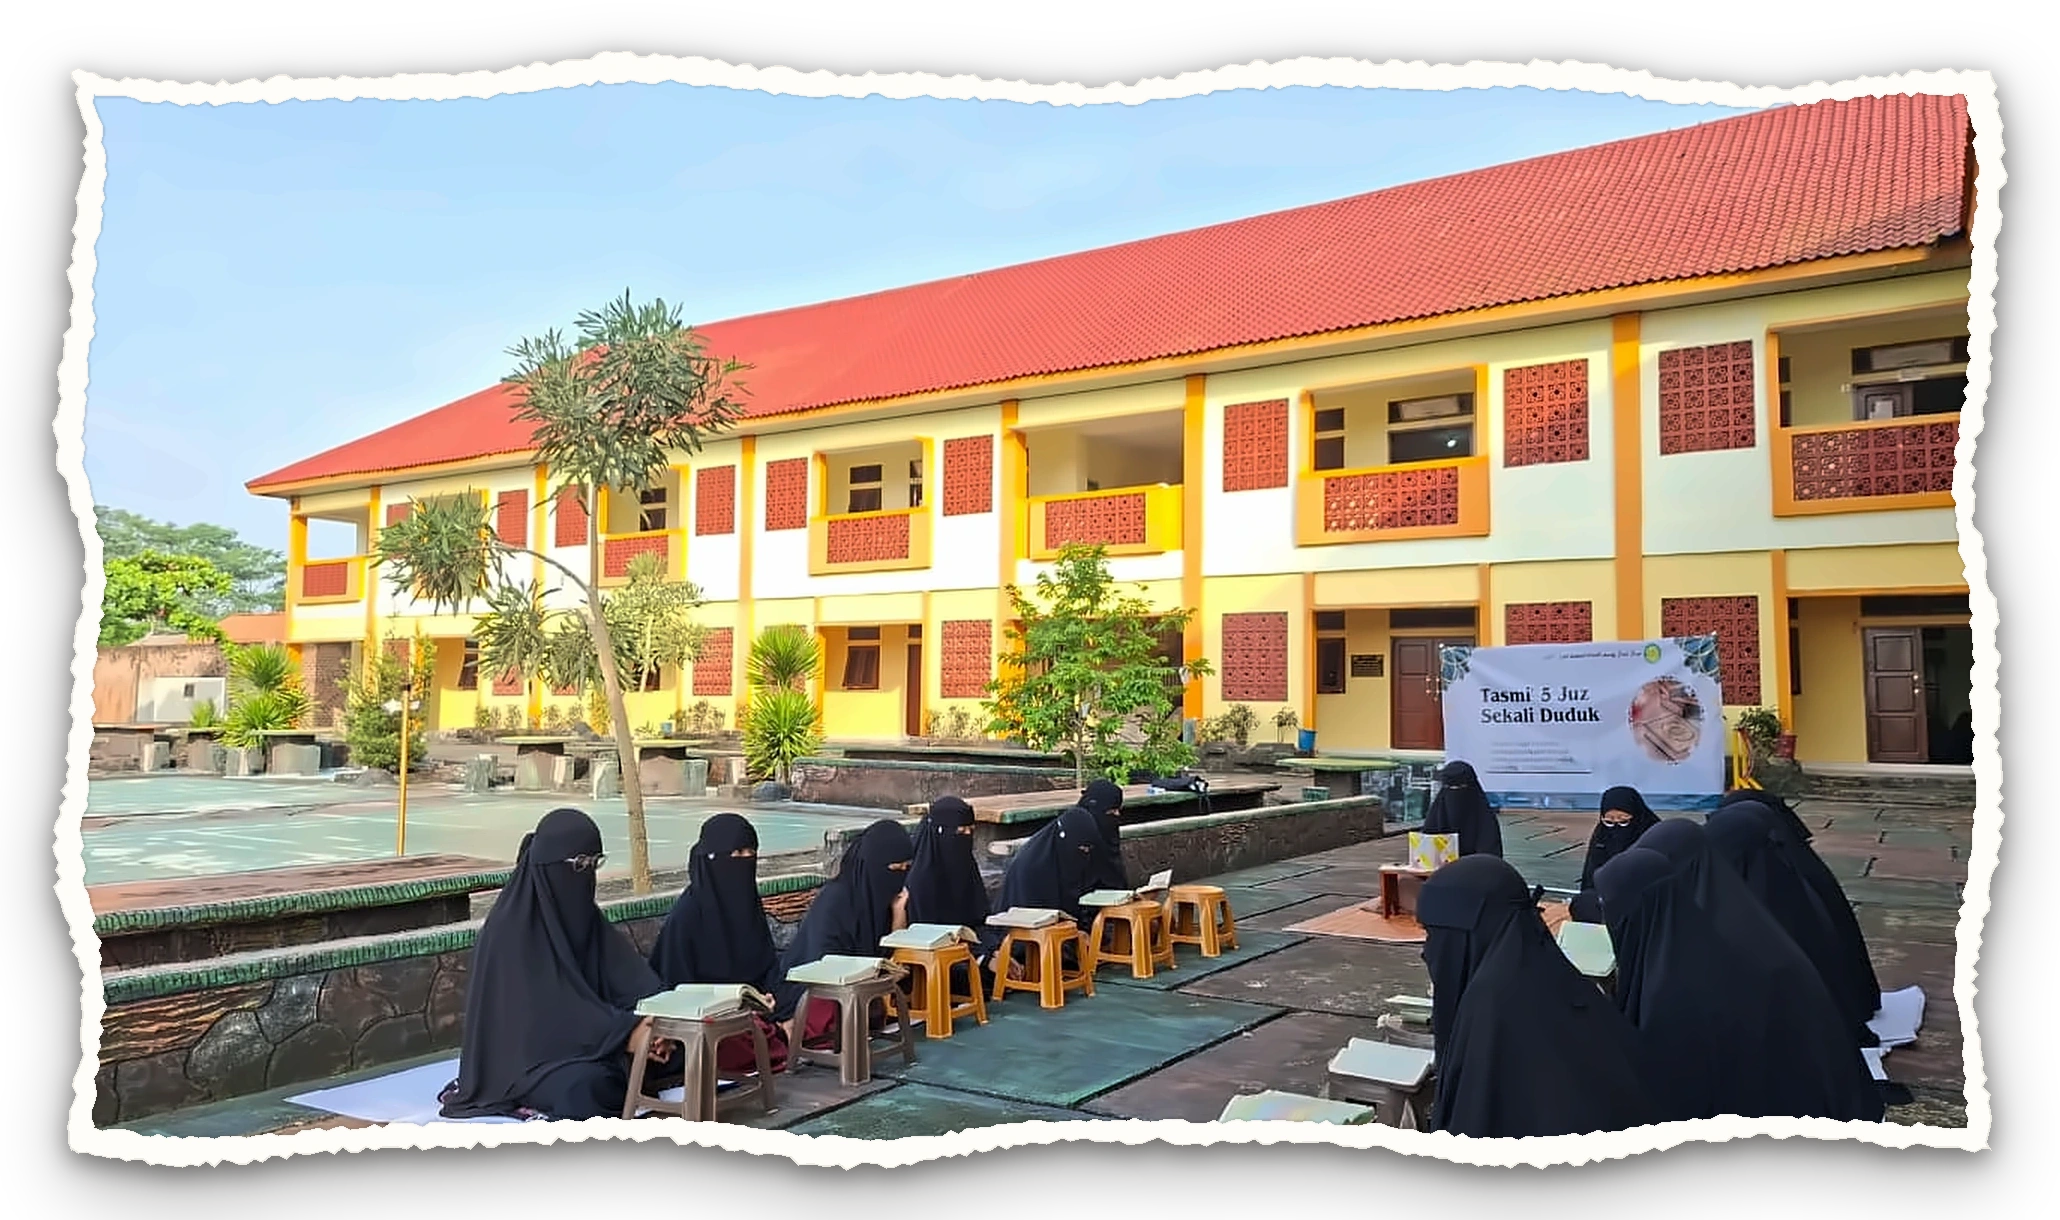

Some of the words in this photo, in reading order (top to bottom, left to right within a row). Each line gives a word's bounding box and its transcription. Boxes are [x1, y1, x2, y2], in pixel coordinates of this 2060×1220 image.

[1541, 687, 1551, 702] 5
[1557, 686, 1590, 702] Juz
[1480, 707, 1534, 723] Sekali
[1540, 706, 1600, 723] Duduk
